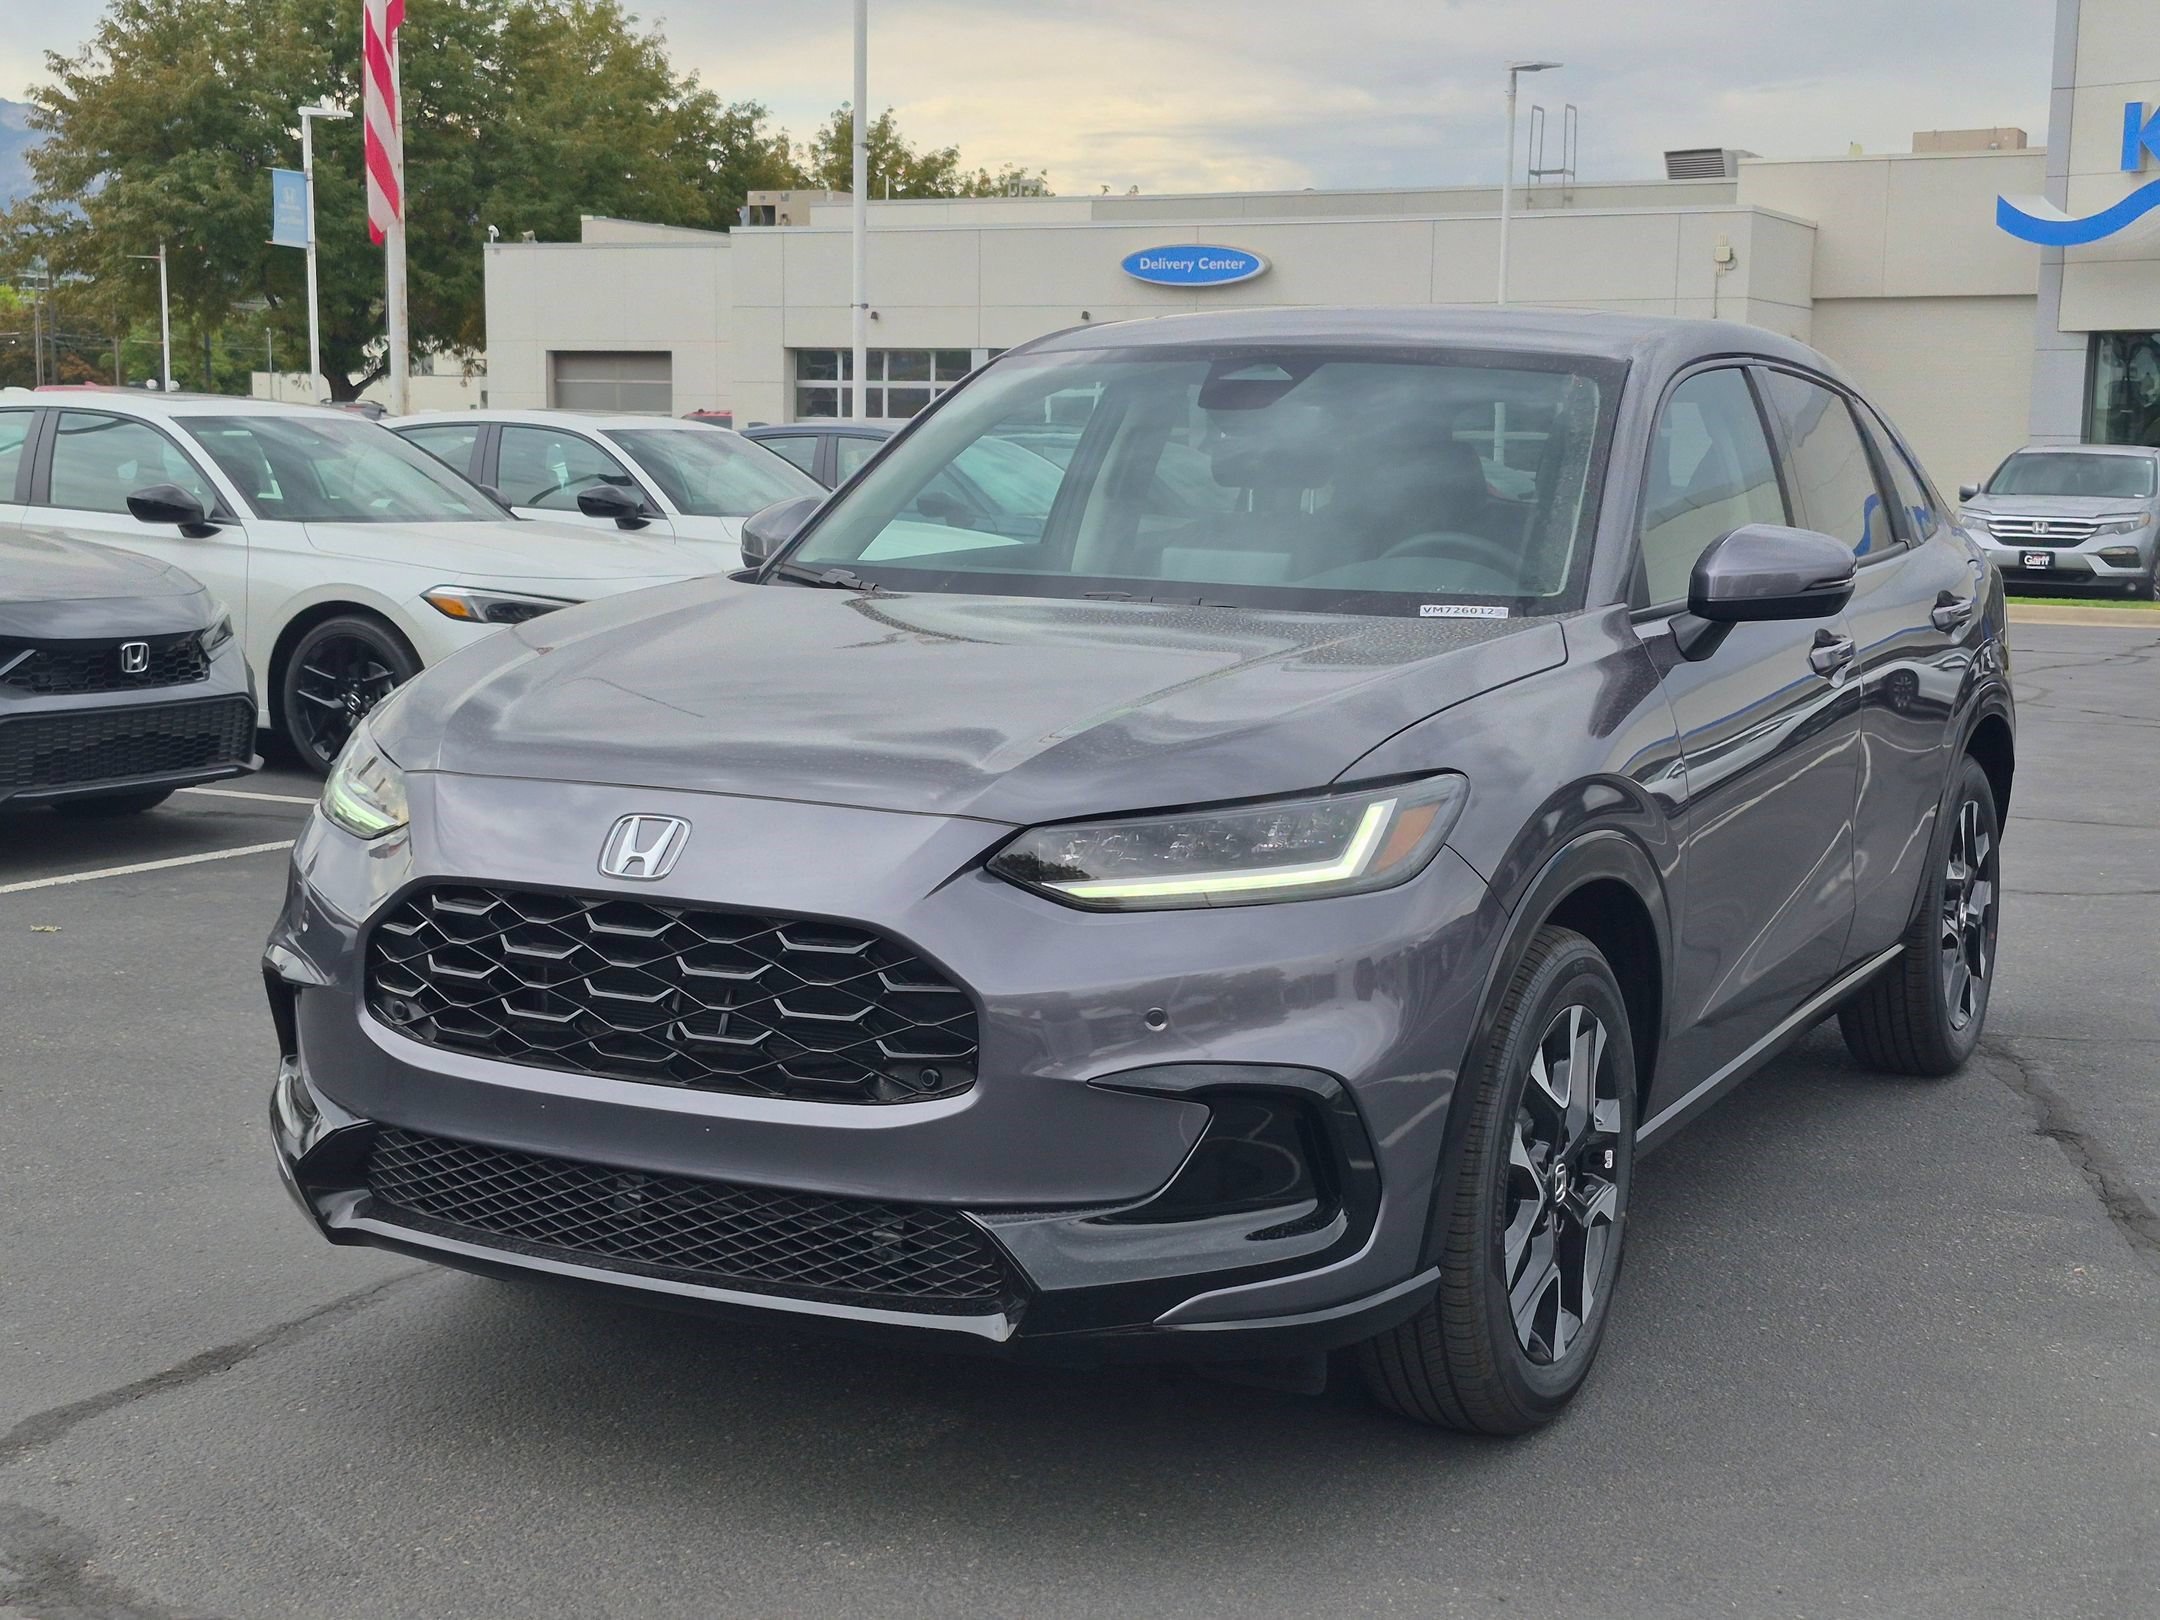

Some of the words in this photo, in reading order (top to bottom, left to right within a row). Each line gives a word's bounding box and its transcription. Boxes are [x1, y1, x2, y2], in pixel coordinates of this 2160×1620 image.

[1139, 257, 1194, 273] Delivery
[1198, 257, 1246, 270] Center
[2024, 554, 2050, 566] Garff
[1423, 606, 1495, 615] VM726012
